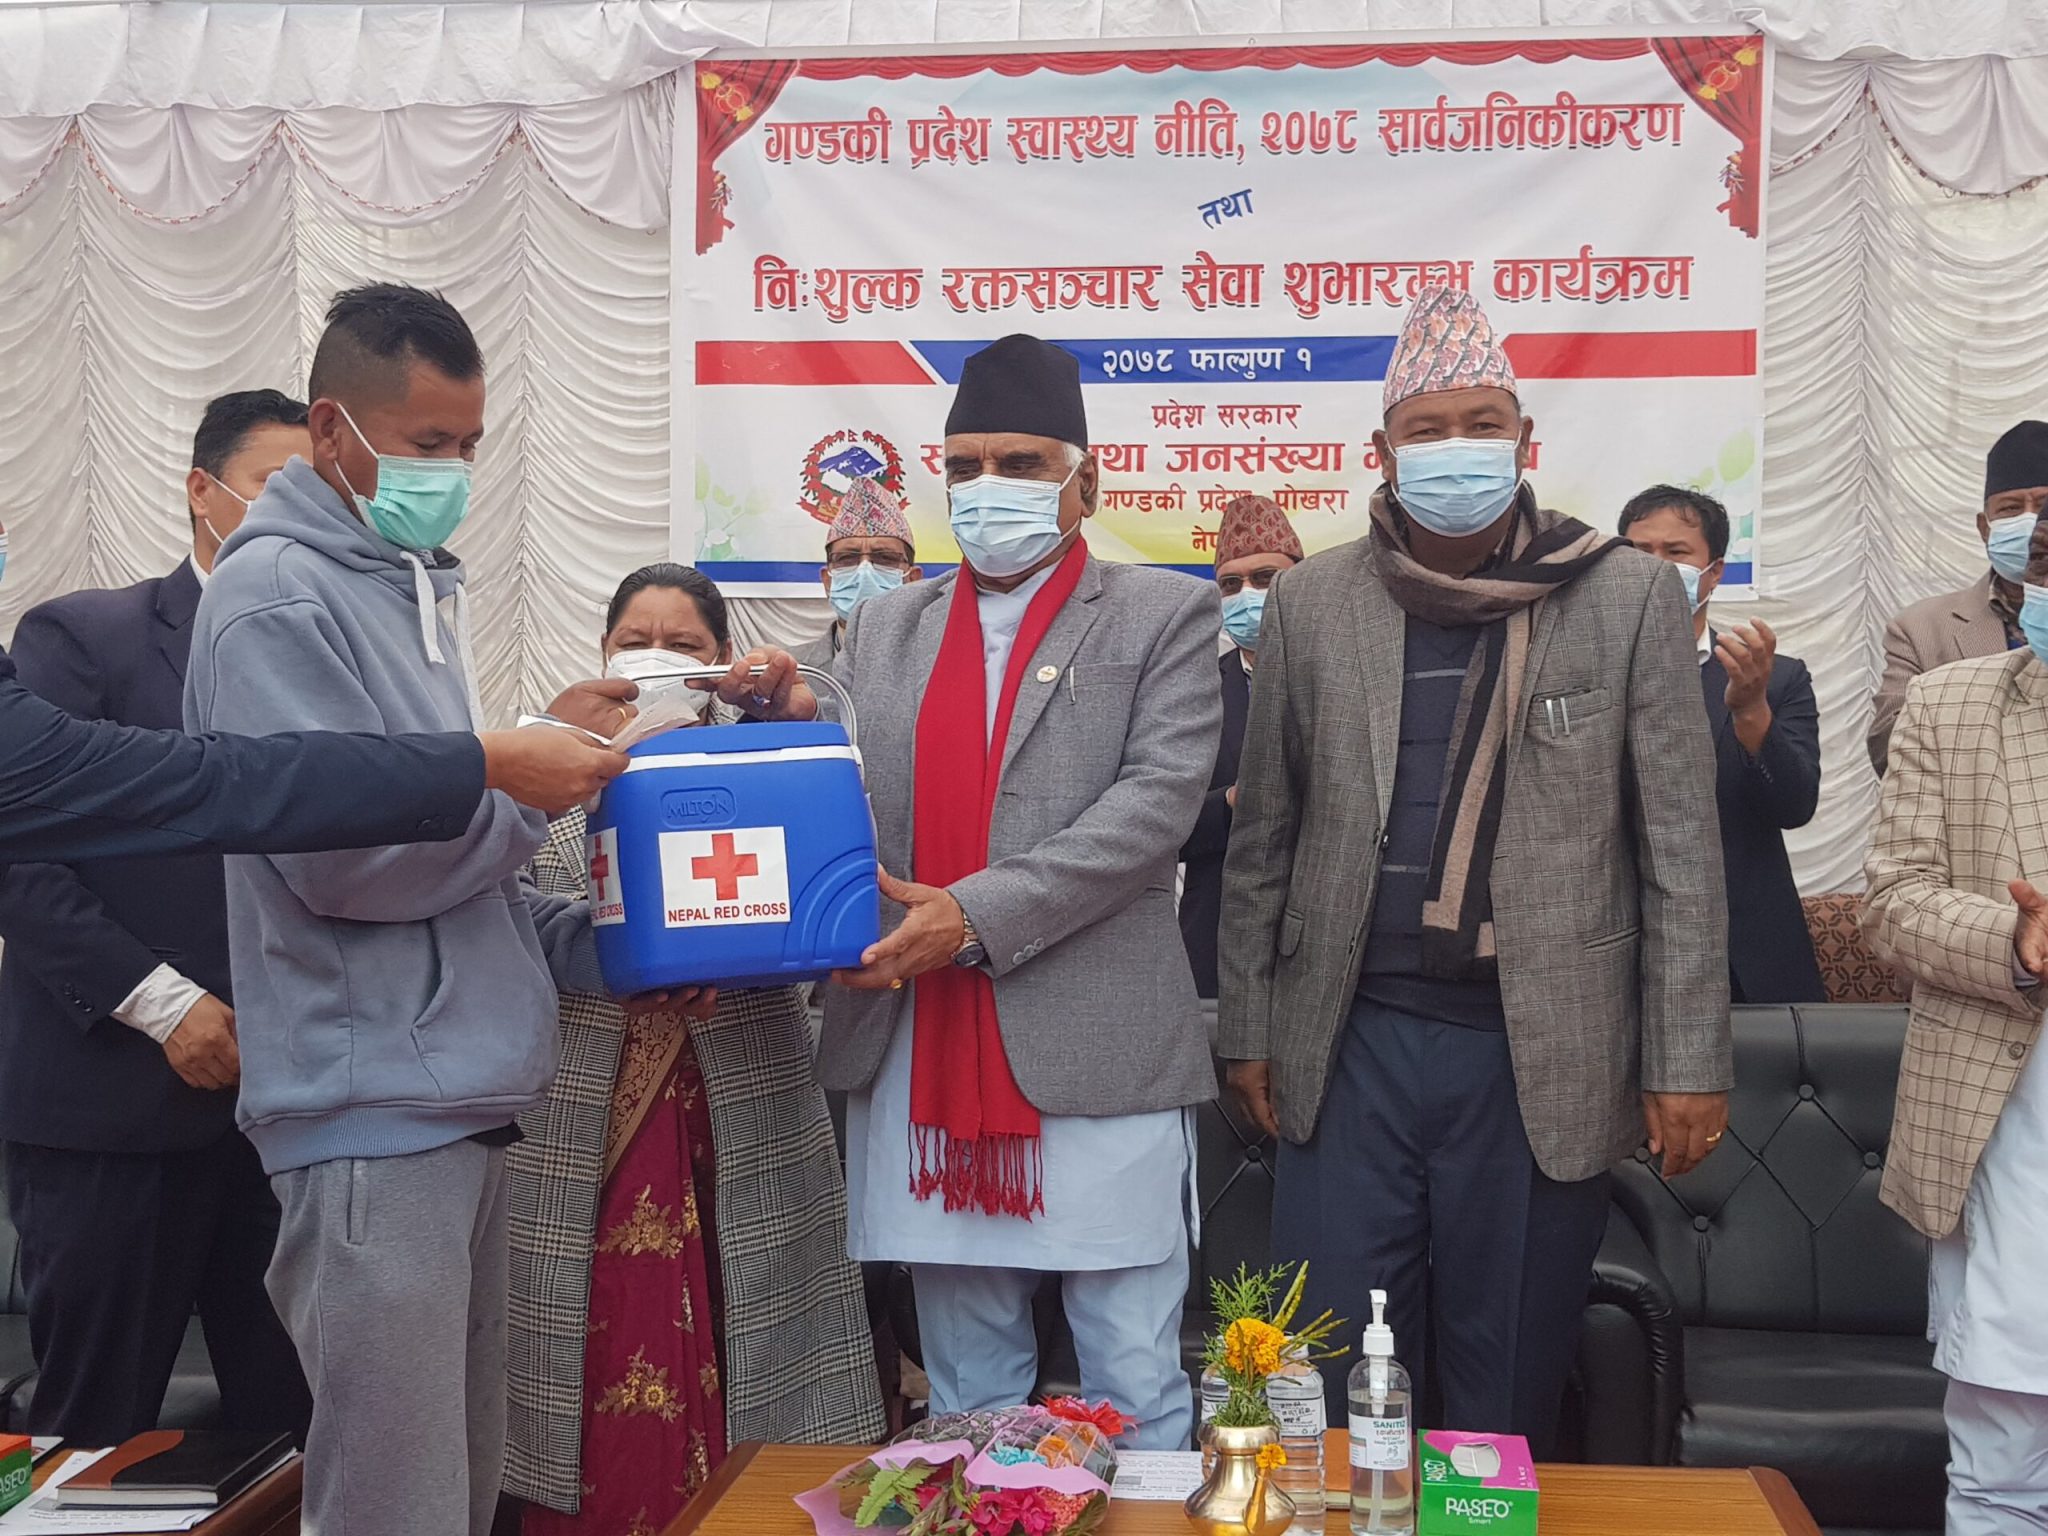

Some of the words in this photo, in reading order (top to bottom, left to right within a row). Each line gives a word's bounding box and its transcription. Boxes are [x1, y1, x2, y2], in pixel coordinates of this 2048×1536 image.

[764, 106, 892, 166] गण्डकी
[907, 105, 992, 167] प्रदेश
[1007, 113, 1139, 162] स्वास्थ्य
[1154, 97, 1246, 165] नीति,
[1260, 108, 1358, 155] २०७८
[1378, 91, 1686, 155] सार्वजनिकीकरण
[1198, 188, 1253, 229] तथा
[1181, 250, 1265, 312] सेवा
[1493, 244, 1695, 303] कार्यक्रम
[1103, 349, 1174, 378] २०७८
[1188, 347, 1286, 380] फाल्गुण
[1297, 347, 1312, 372] १
[1151, 398, 1206, 429] प्रदेश
[1217, 403, 1303, 430] सरकार
[1165, 436, 1345, 474] जनसंख्या
[1102, 482, 1187, 513] गण्डकी
[1272, 488, 1350, 511] पोखरा
[668, 907, 711, 923] NEPAL
[714, 905, 740, 919] RED
[743, 902, 787, 917] CROSS
[0, 1467, 27, 1494] ASEO
